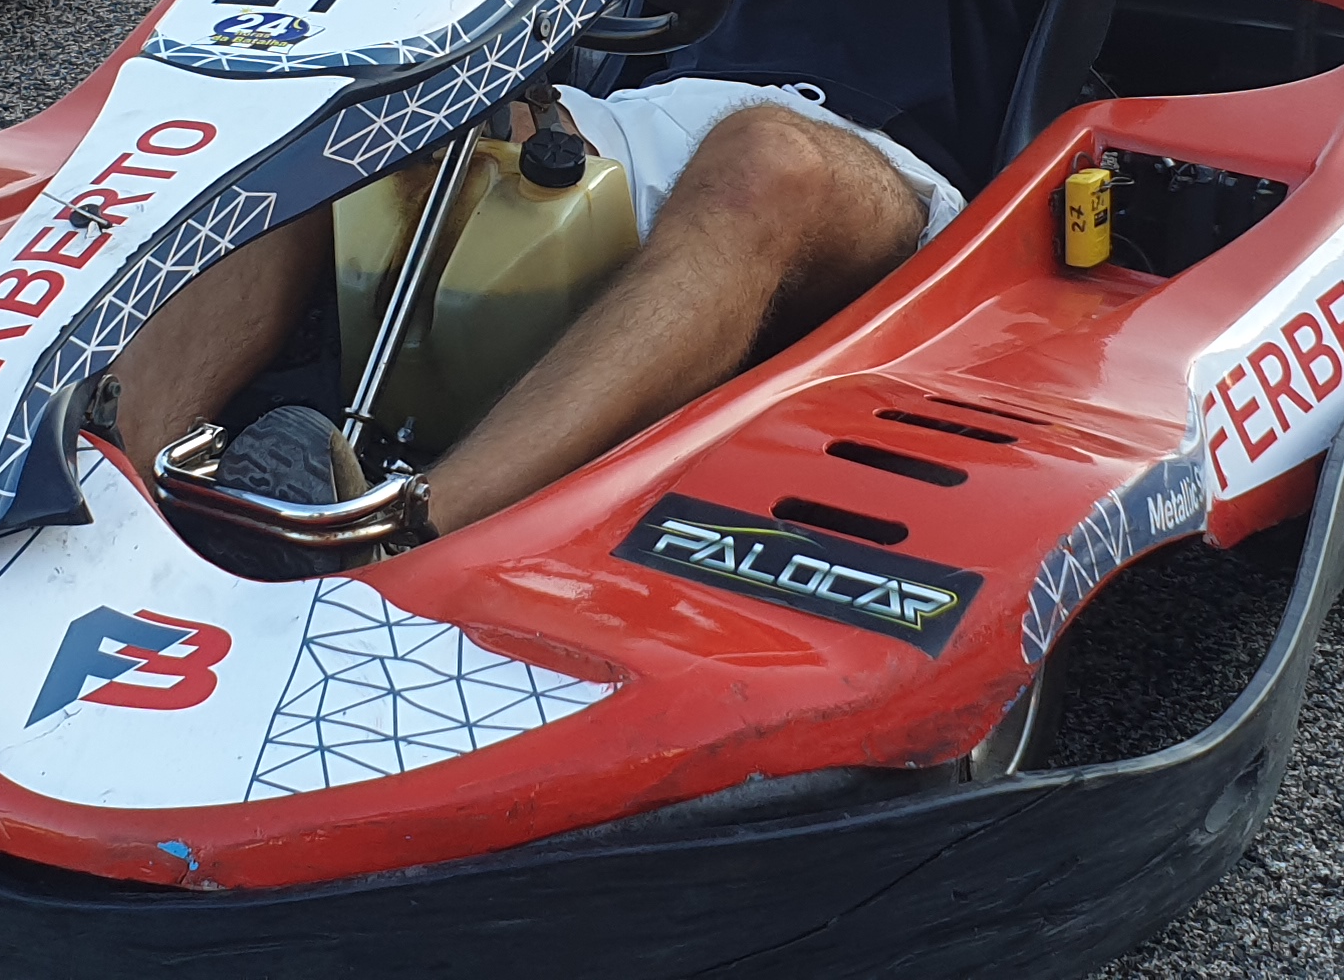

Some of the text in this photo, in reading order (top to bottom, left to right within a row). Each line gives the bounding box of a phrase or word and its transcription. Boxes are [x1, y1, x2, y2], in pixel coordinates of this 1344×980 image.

[223, 13, 294, 37] 24
[232, 36, 288, 47] Batalha
[1146, 476, 1200, 536] Metallic
[653, 516, 959, 620] PALOCAR
